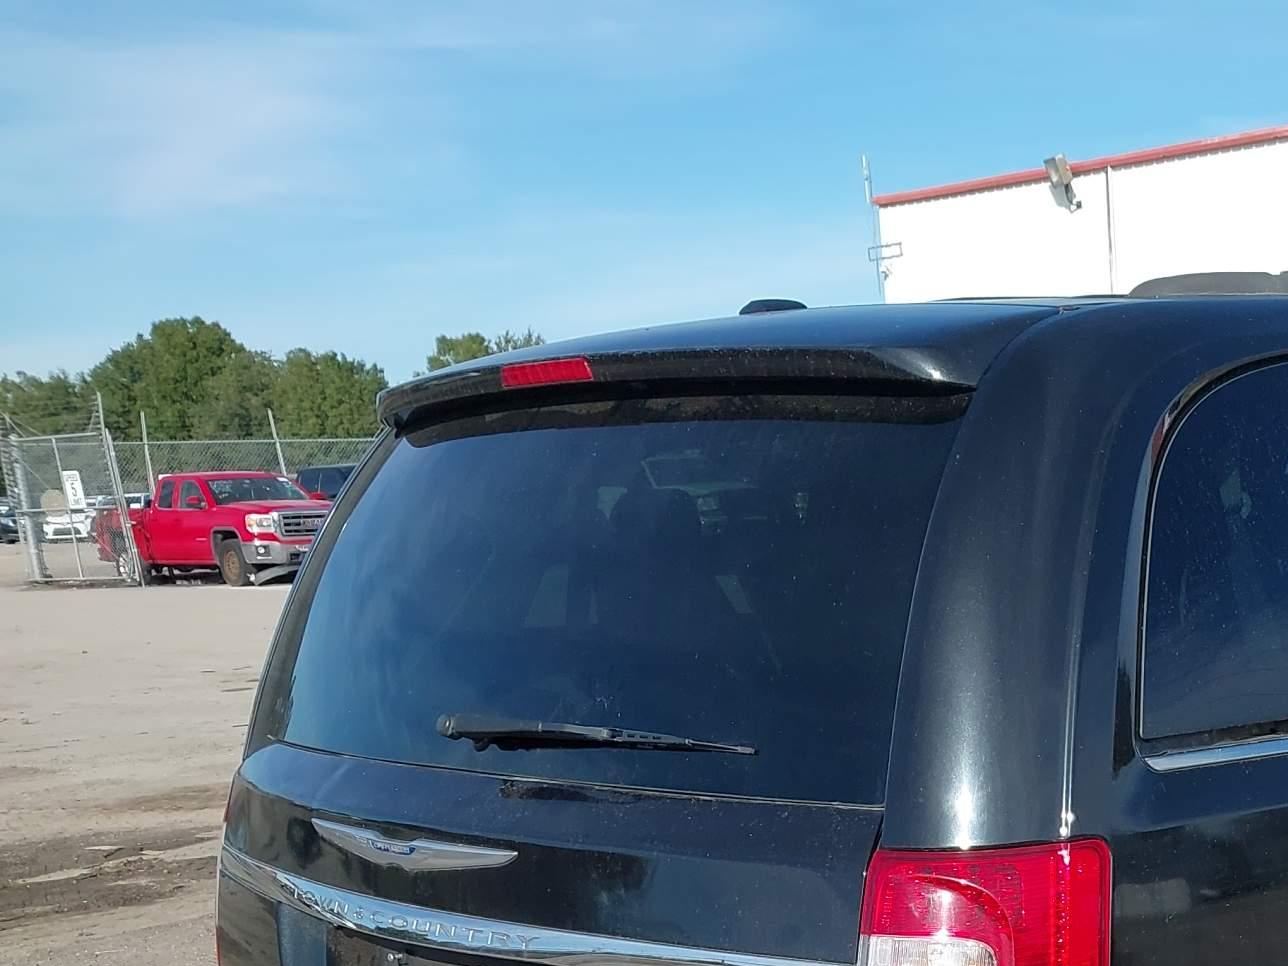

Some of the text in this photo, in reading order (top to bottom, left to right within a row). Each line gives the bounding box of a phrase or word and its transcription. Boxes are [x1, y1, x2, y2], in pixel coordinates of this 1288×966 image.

[71, 482, 78, 497] 5
[287, 886, 349, 914] TOWN
[369, 910, 541, 950] COUNTRY
